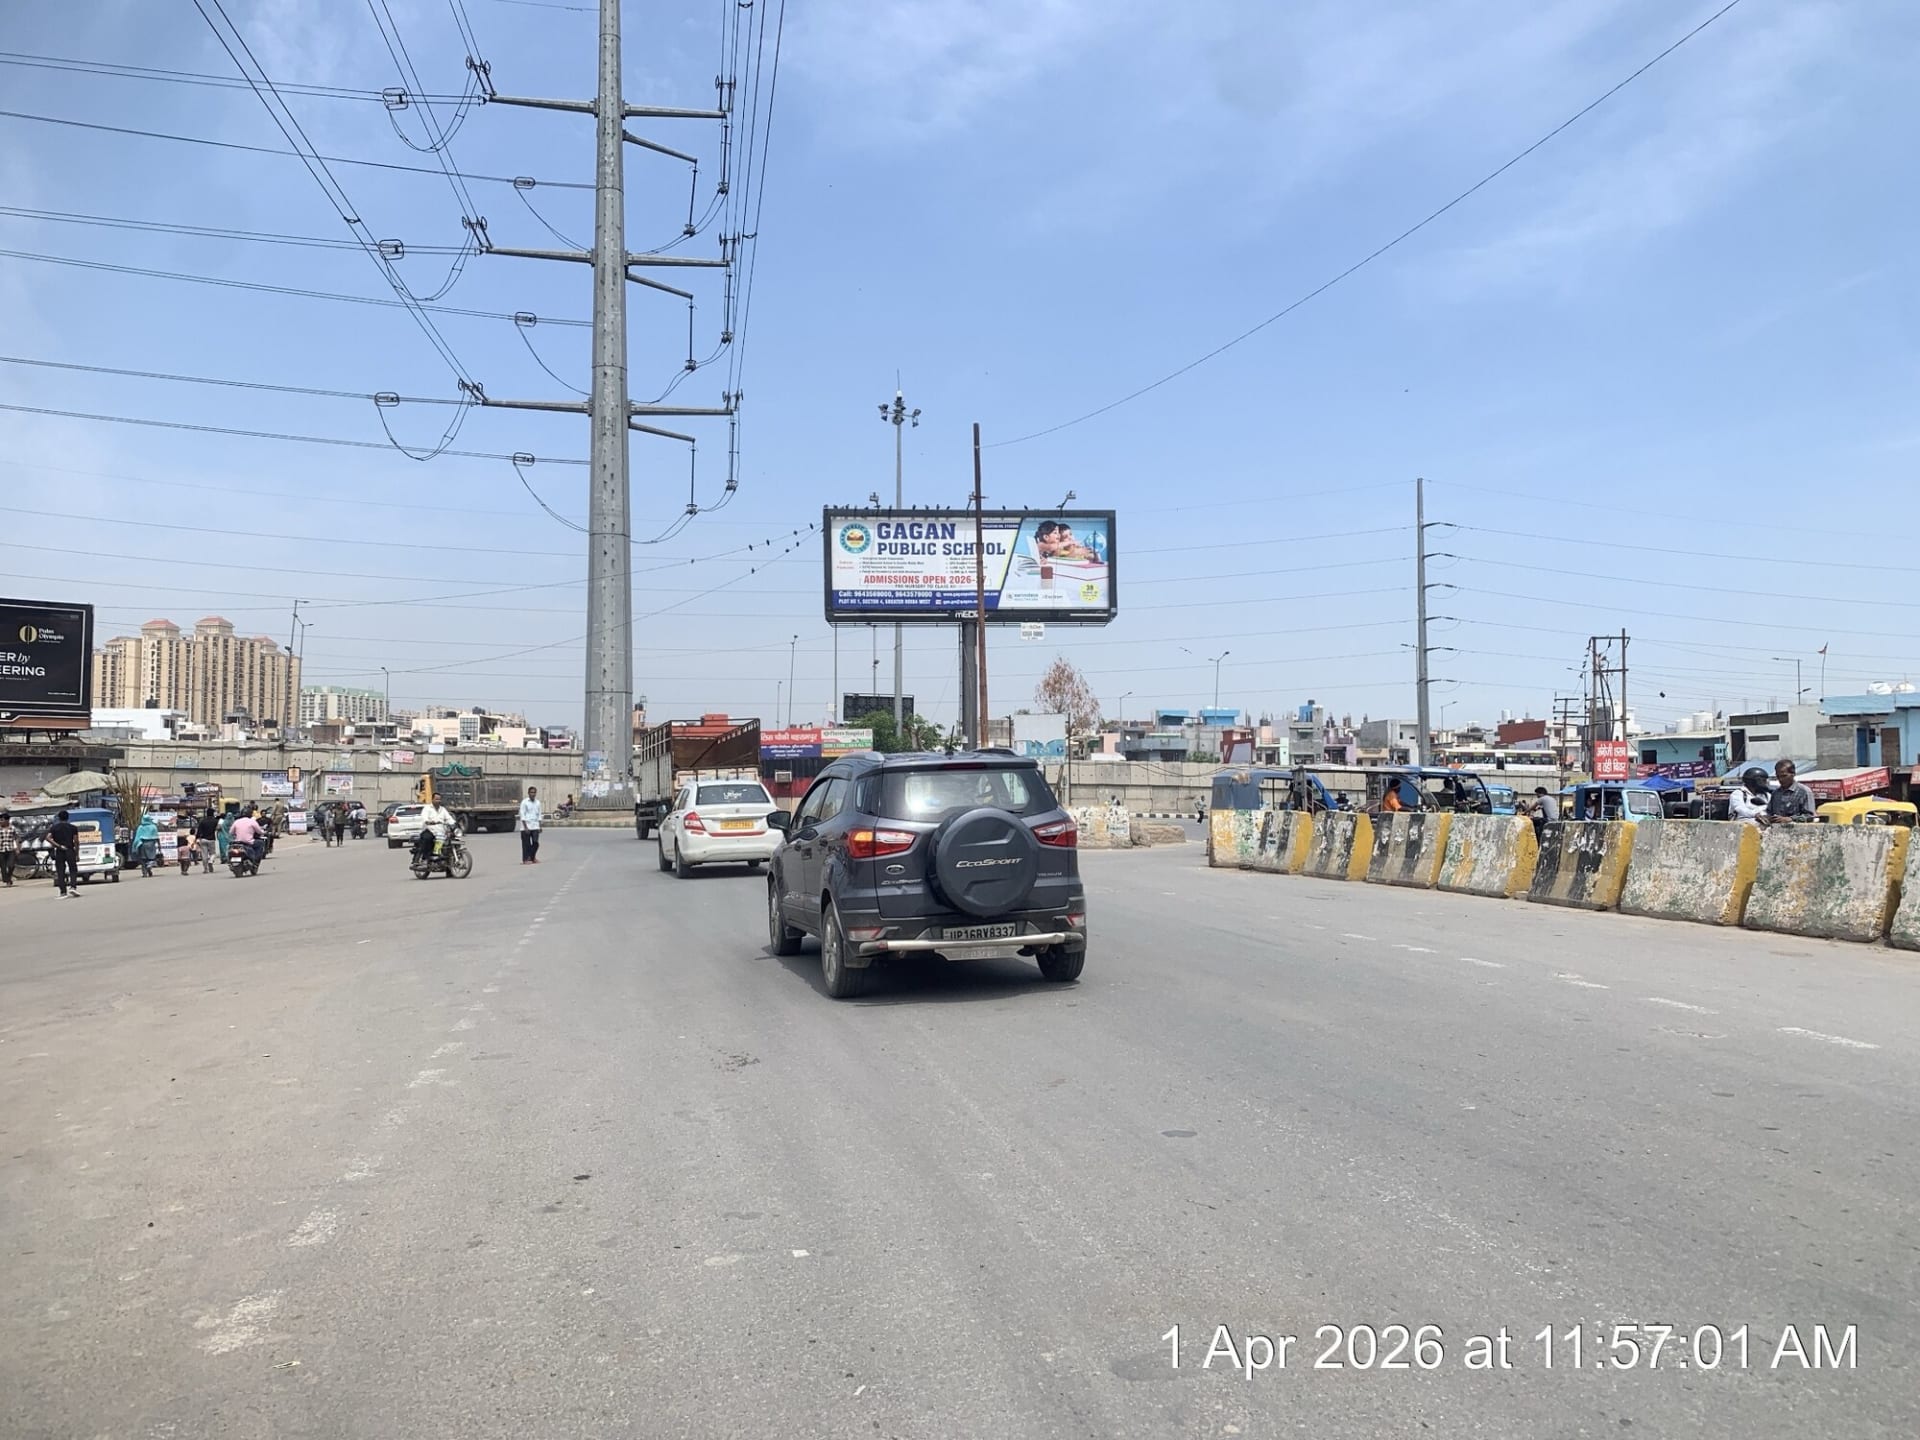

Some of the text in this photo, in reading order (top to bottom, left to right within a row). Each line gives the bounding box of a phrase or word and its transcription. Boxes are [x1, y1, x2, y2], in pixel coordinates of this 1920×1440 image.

[877, 522, 956, 540] GAGAN
[877, 542, 1006, 555] PUBLIC SCHOL
[863, 575, 987, 584] ADMISSIONS OPEN 2026-7
[17, 653, 31, 664] by
[0, 665, 46, 676] ERING
